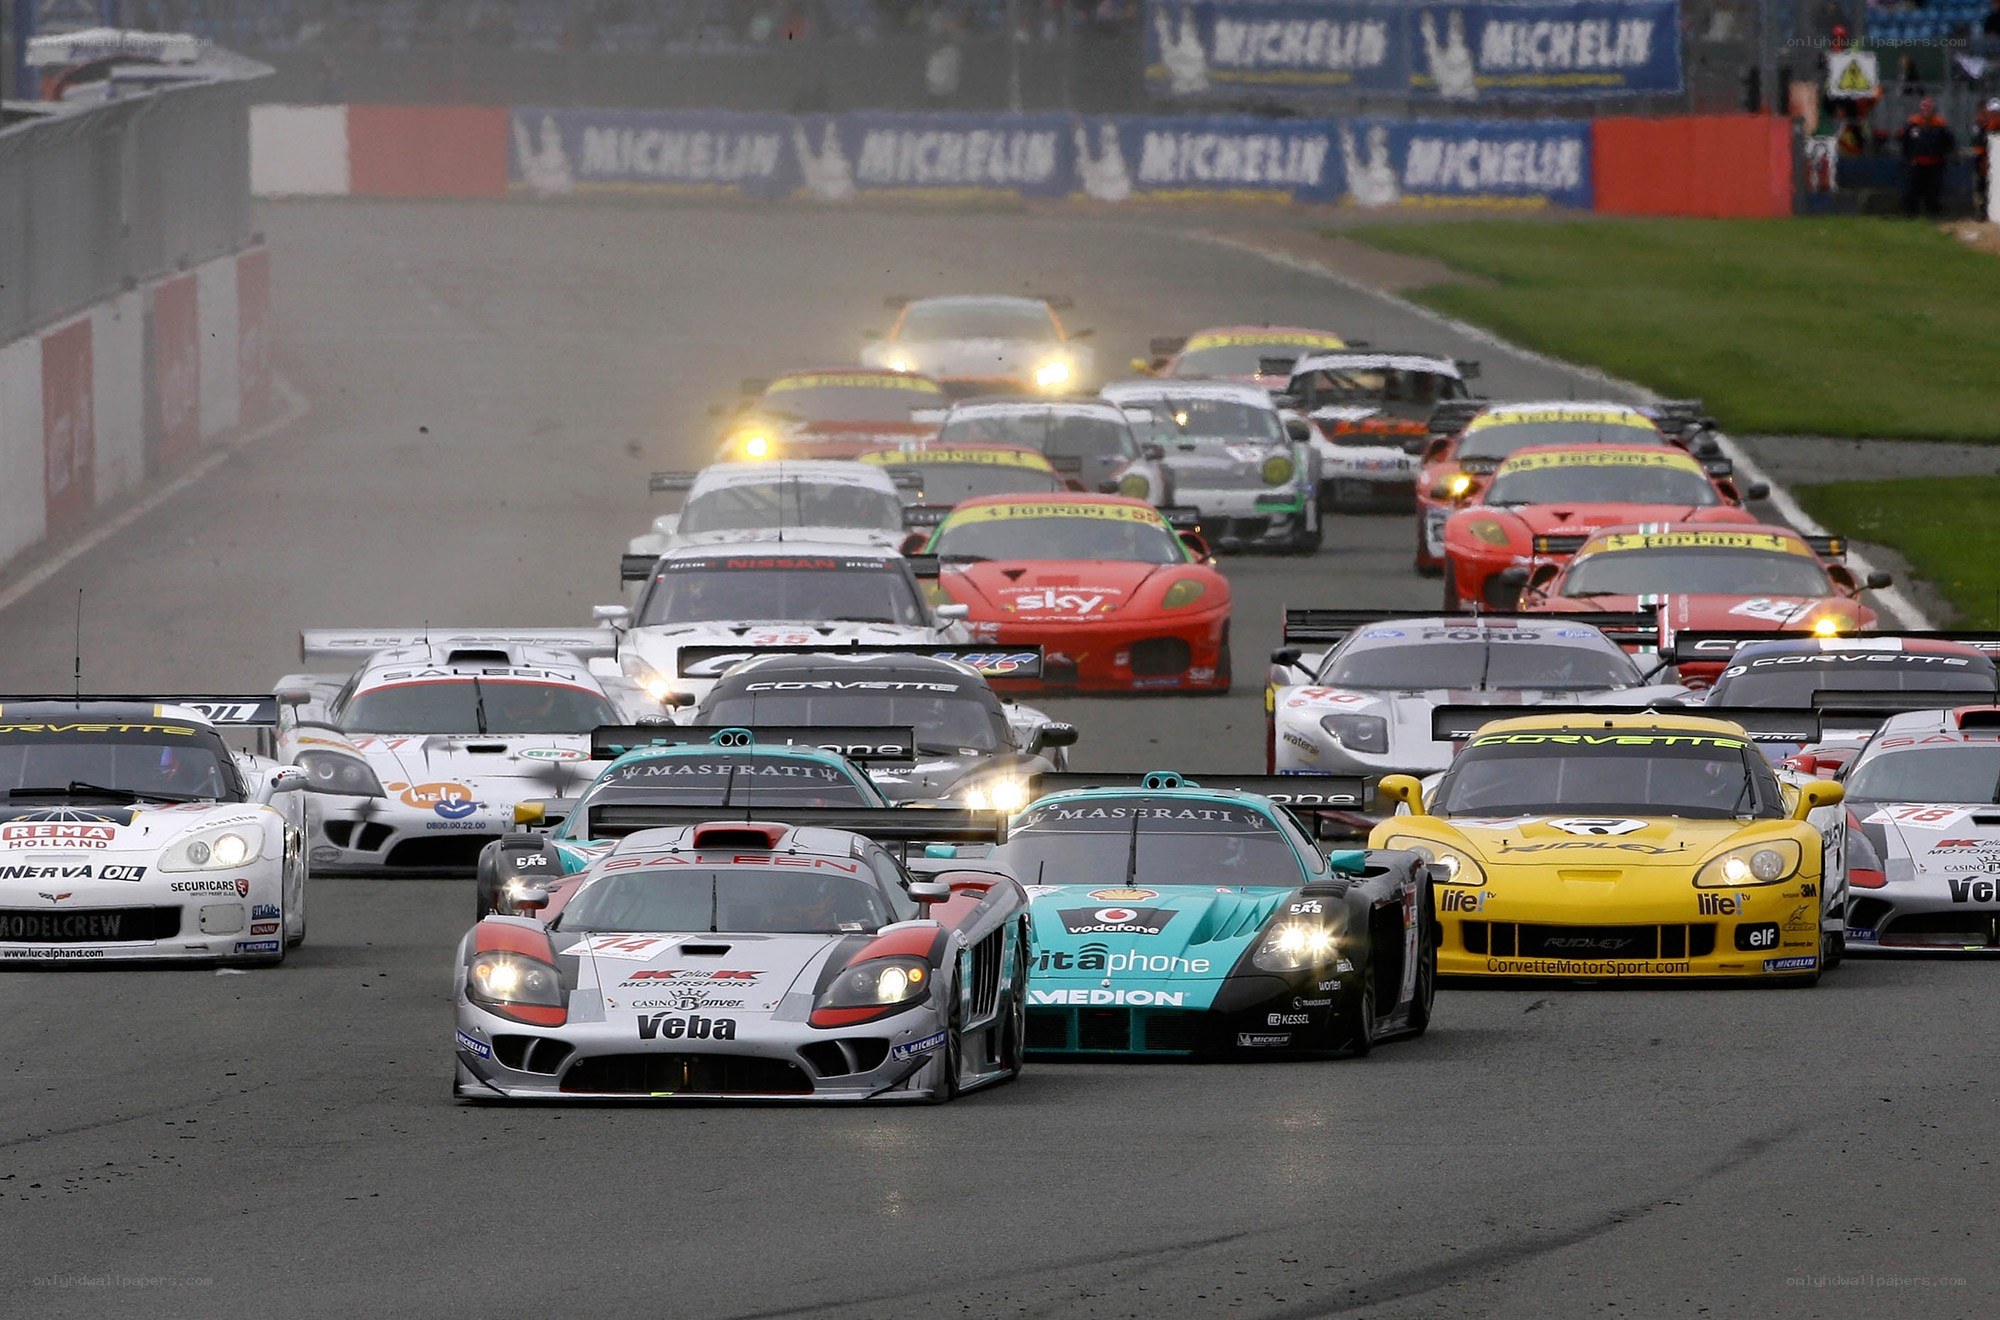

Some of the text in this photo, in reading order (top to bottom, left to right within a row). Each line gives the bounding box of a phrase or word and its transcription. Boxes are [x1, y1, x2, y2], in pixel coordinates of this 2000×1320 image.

[1213, 19, 1388, 67] MICHELIN
[1480, 19, 1656, 67] MICHELIN
[580, 125, 781, 178] MICHELIN
[857, 128, 1057, 183] MICHELIN
[1138, 132, 1329, 187] MICHELIN
[1403, 136, 1584, 189] MICHELIN
[726, 559, 837, 569] NISSAN
[1015, 590, 1104, 614] sky
[753, 634, 810, 646] 35
[1422, 632, 1541, 641] FORD
[1752, 654, 1970, 667] CORVETTE
[383, 668, 577, 682] SALEEN
[1726, 665, 1748, 678] 9
[745, 680, 960, 693] CORVETTE
[1472, 734, 1749, 749] CORVETTE
[1880, 734, 2000, 750] SAL
[643, 764, 813, 778] MASERATI
[410, 786, 463, 805] help
[1057, 807, 1233, 823] MASERATI
[9, 826, 109, 839] REMA
[9, 840, 107, 849] HOLLAND
[1497, 840, 1689, 855] RIDLEY
[603, 855, 857, 874] SALEEN
[1944, 864, 1986, 872] CASINO
[103, 866, 141, 880] OIL
[171, 880, 234, 892] SECURICARS
[1801, 884, 1817, 897] 3M
[1069, 923, 1160, 935] vodafone
[1750, 929, 1775, 946] elf
[592, 937, 661, 953] 14
[4, 948, 104, 959] www.luc-alphand.com
[1487, 958, 1690, 976] CorvetteMotorSport.com
[1776, 958, 1815, 968] MICHELIN
[628, 969, 769, 980] K plus K
[617, 980, 762, 988] MOTORSPORT
[632, 999, 677, 1008] CASINO
[1028, 989, 1184, 1006] MEDION
[637, 1011, 737, 1040] Veba
[1281, 1014, 1310, 1025] KESSEL
[909, 1032, 946, 1053] MICHELIN
[1252, 1035, 1291, 1043] MICHELIN
